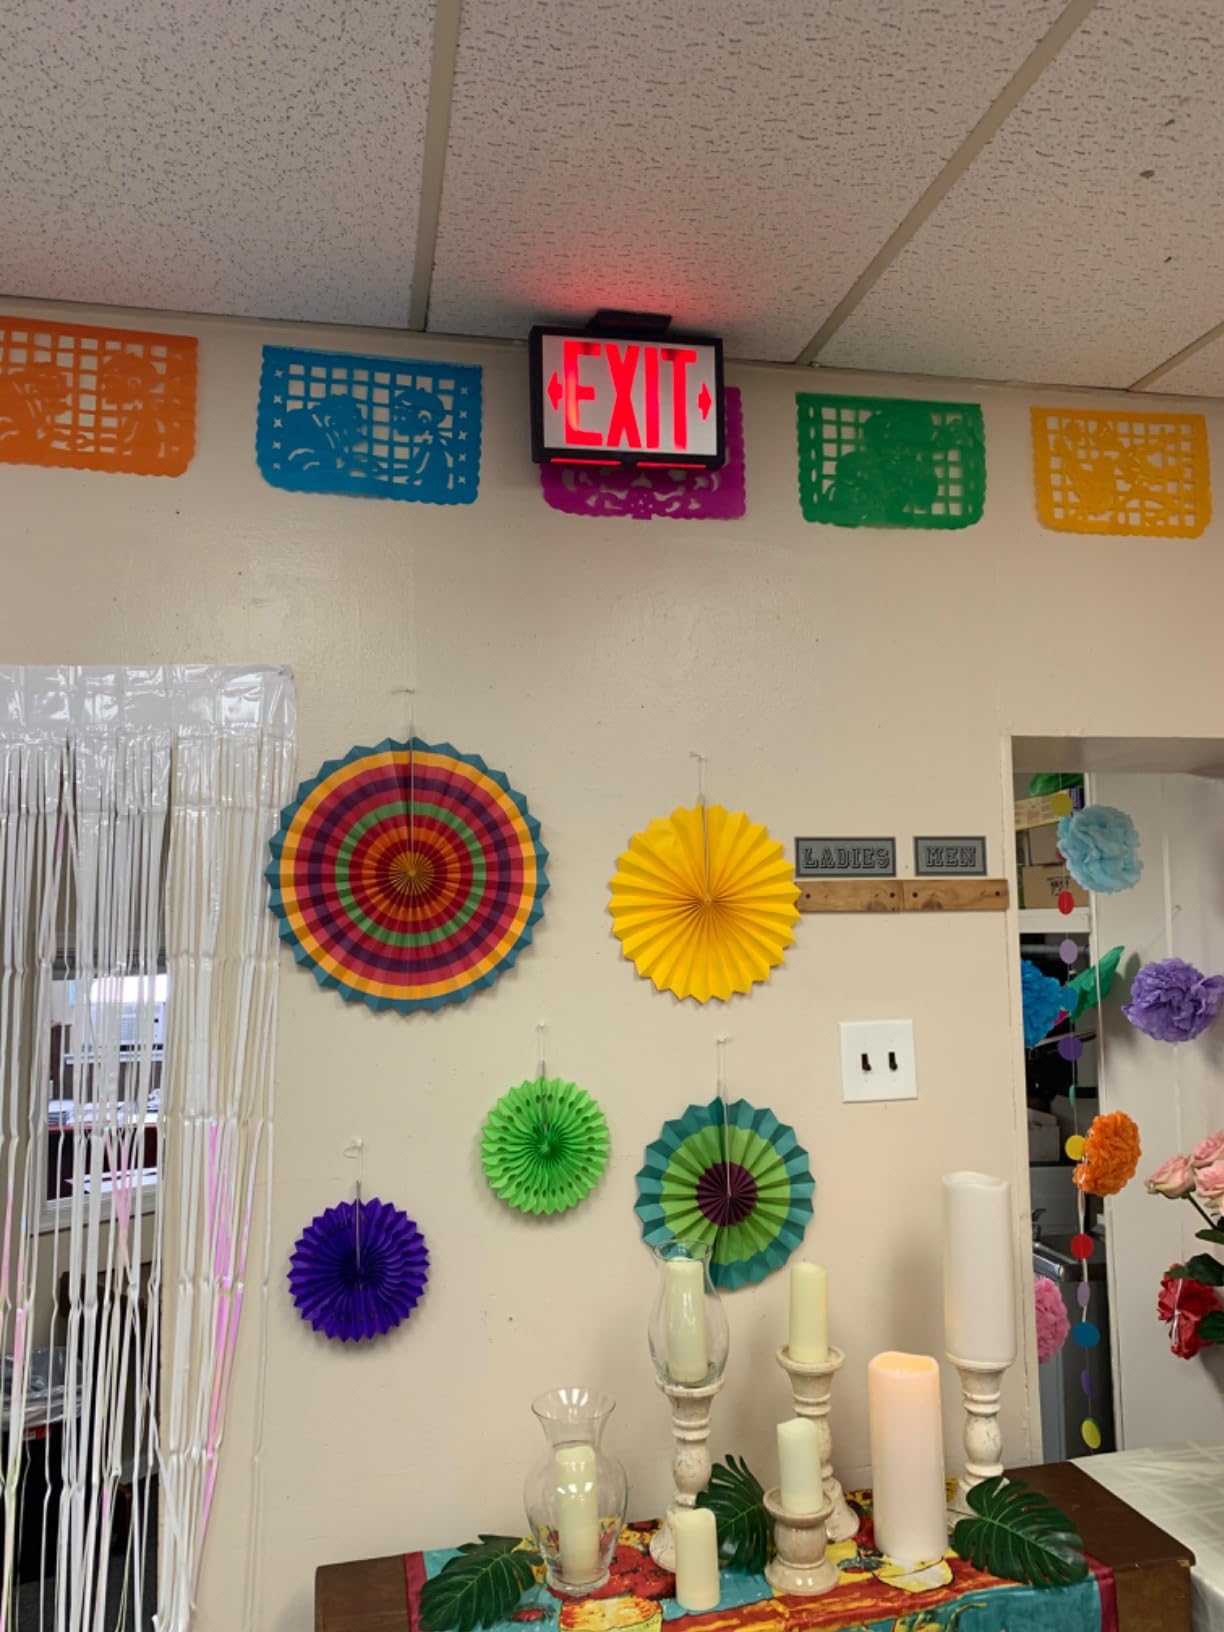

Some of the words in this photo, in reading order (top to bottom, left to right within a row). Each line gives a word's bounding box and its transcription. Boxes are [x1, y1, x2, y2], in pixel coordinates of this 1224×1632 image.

[563, 340, 697, 451] EXIT
[803, 847, 890, 869] LADIES
[925, 846, 977, 867] MEN
